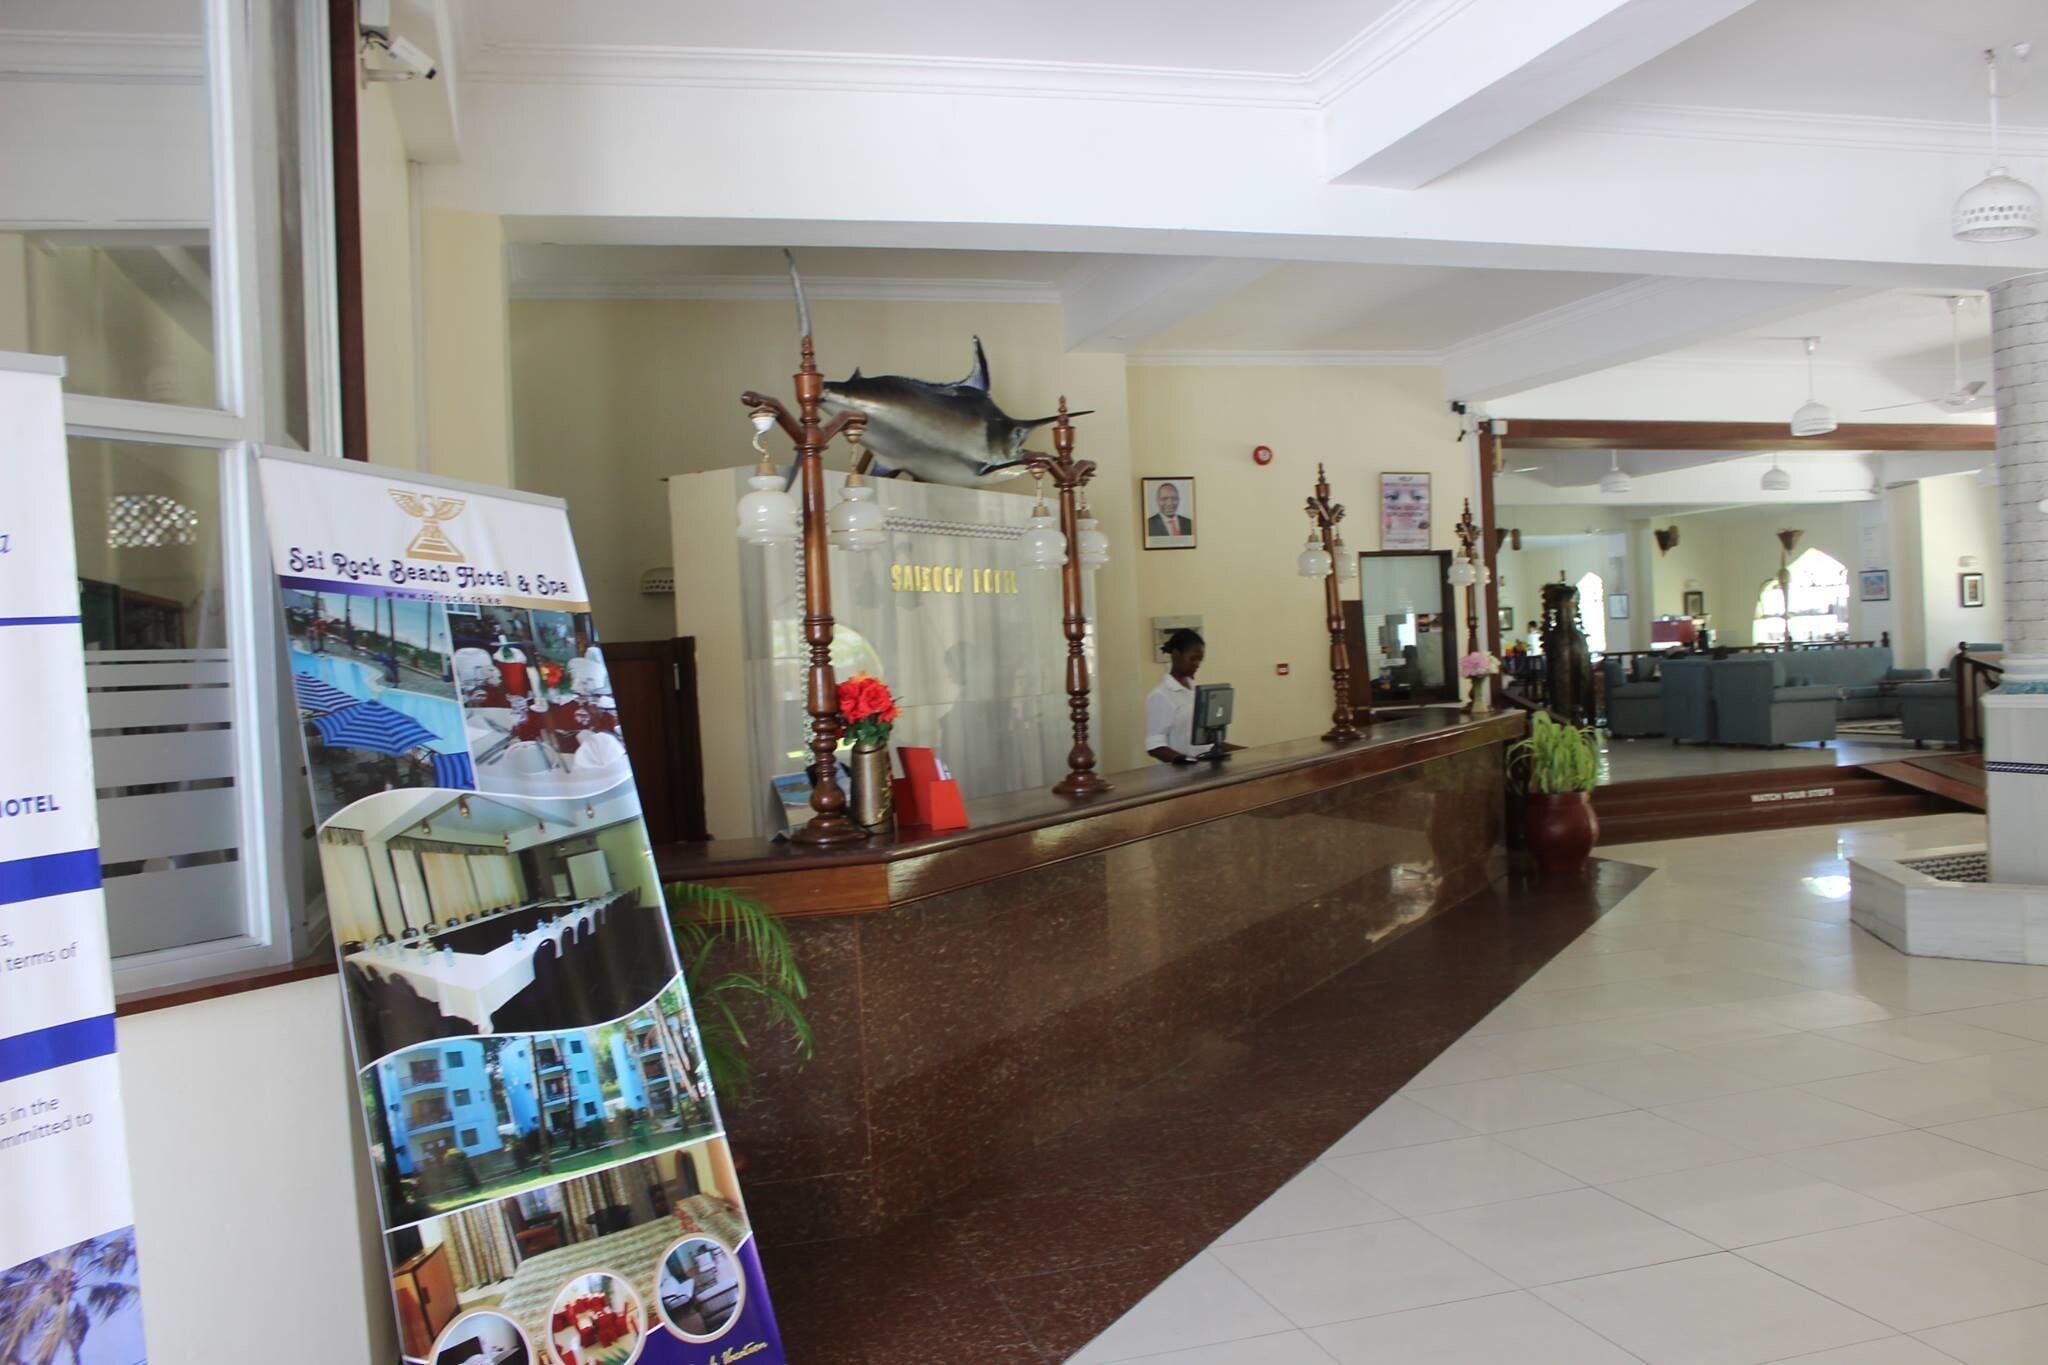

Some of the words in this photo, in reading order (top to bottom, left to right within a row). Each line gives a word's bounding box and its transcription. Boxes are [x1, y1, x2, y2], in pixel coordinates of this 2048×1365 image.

[289, 547, 325, 572] Sai
[331, 552, 382, 580] Rock
[389, 559, 450, 585] Beach
[456, 565, 512, 589] Hotel
[517, 574, 532, 595] &
[536, 573, 570, 596] Spa
[0, 794, 60, 818] OTEL
[1751, 793, 1782, 802] WATCH
[1783, 790, 1806, 800] YOUR
[1807, 788, 1834, 798] STEPS
[6, 950, 56, 972] terms
[60, 941, 78, 960] of
[10, 1106, 26, 1121] in
[31, 1098, 60, 1116] the
[76, 1113, 93, 1127] to
